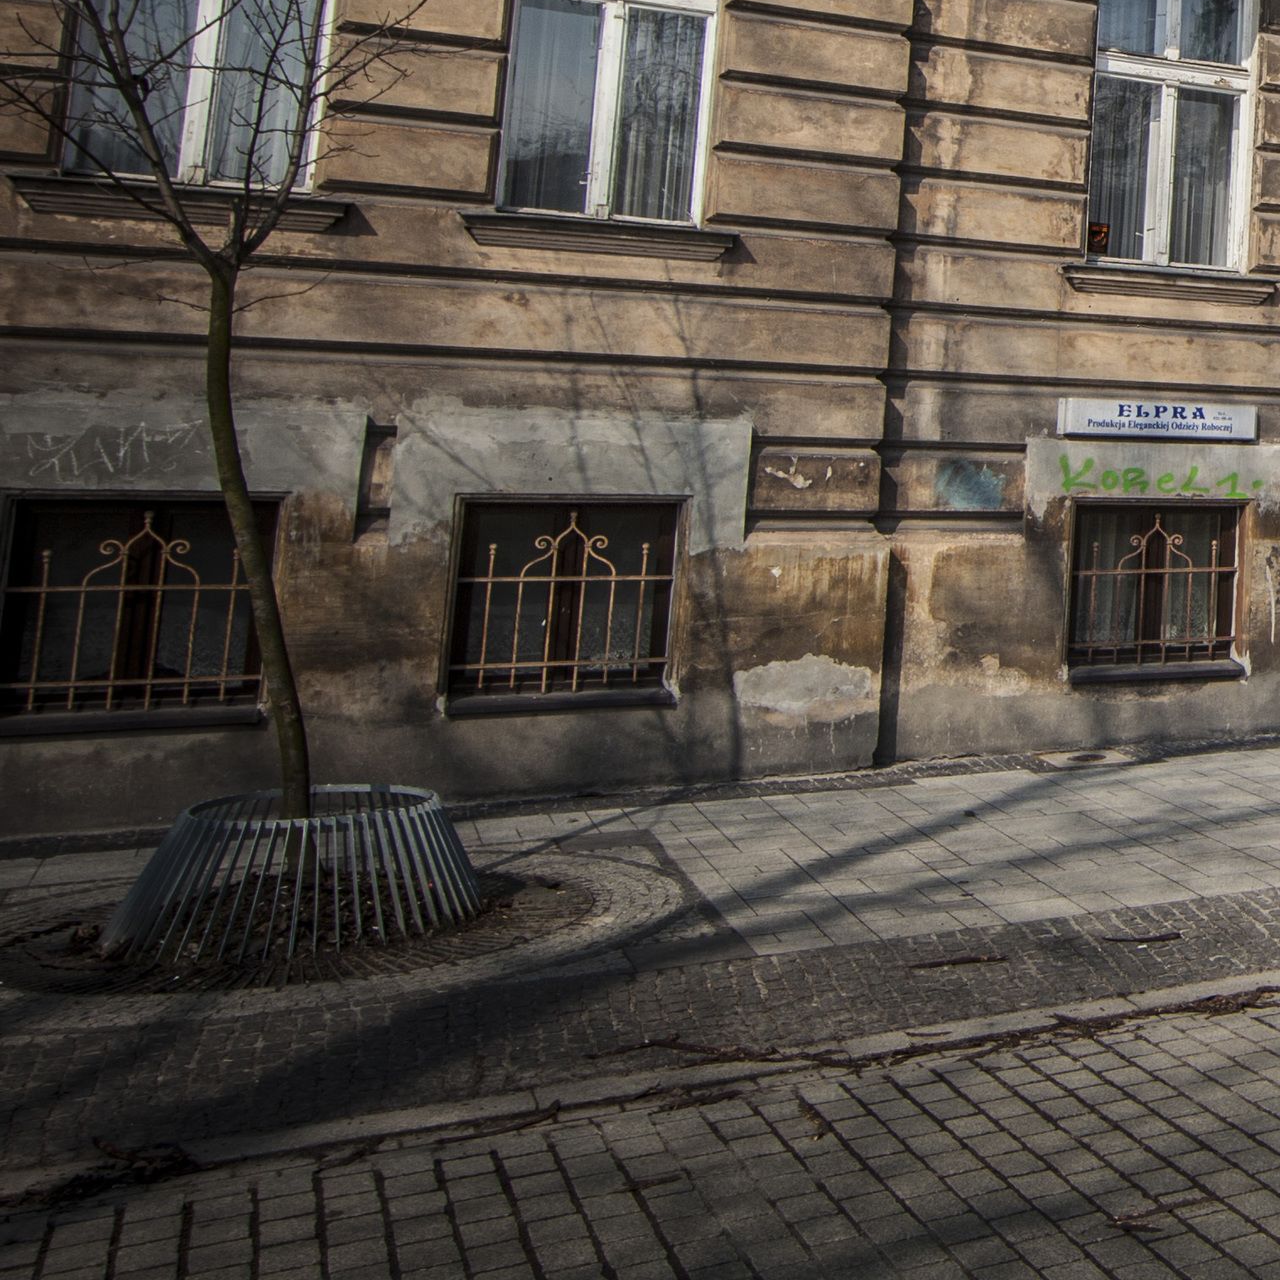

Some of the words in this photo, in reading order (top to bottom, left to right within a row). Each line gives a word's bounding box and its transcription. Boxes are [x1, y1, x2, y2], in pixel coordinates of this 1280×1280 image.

[1118, 403, 1206, 420] ELPRA
[1087, 418, 1126, 430] Produkcja
[1128, 420, 1170, 432] Eleganckiej
[1171, 422, 1199, 433] Odzieży
[1201, 422, 1233, 434] Roboczej
